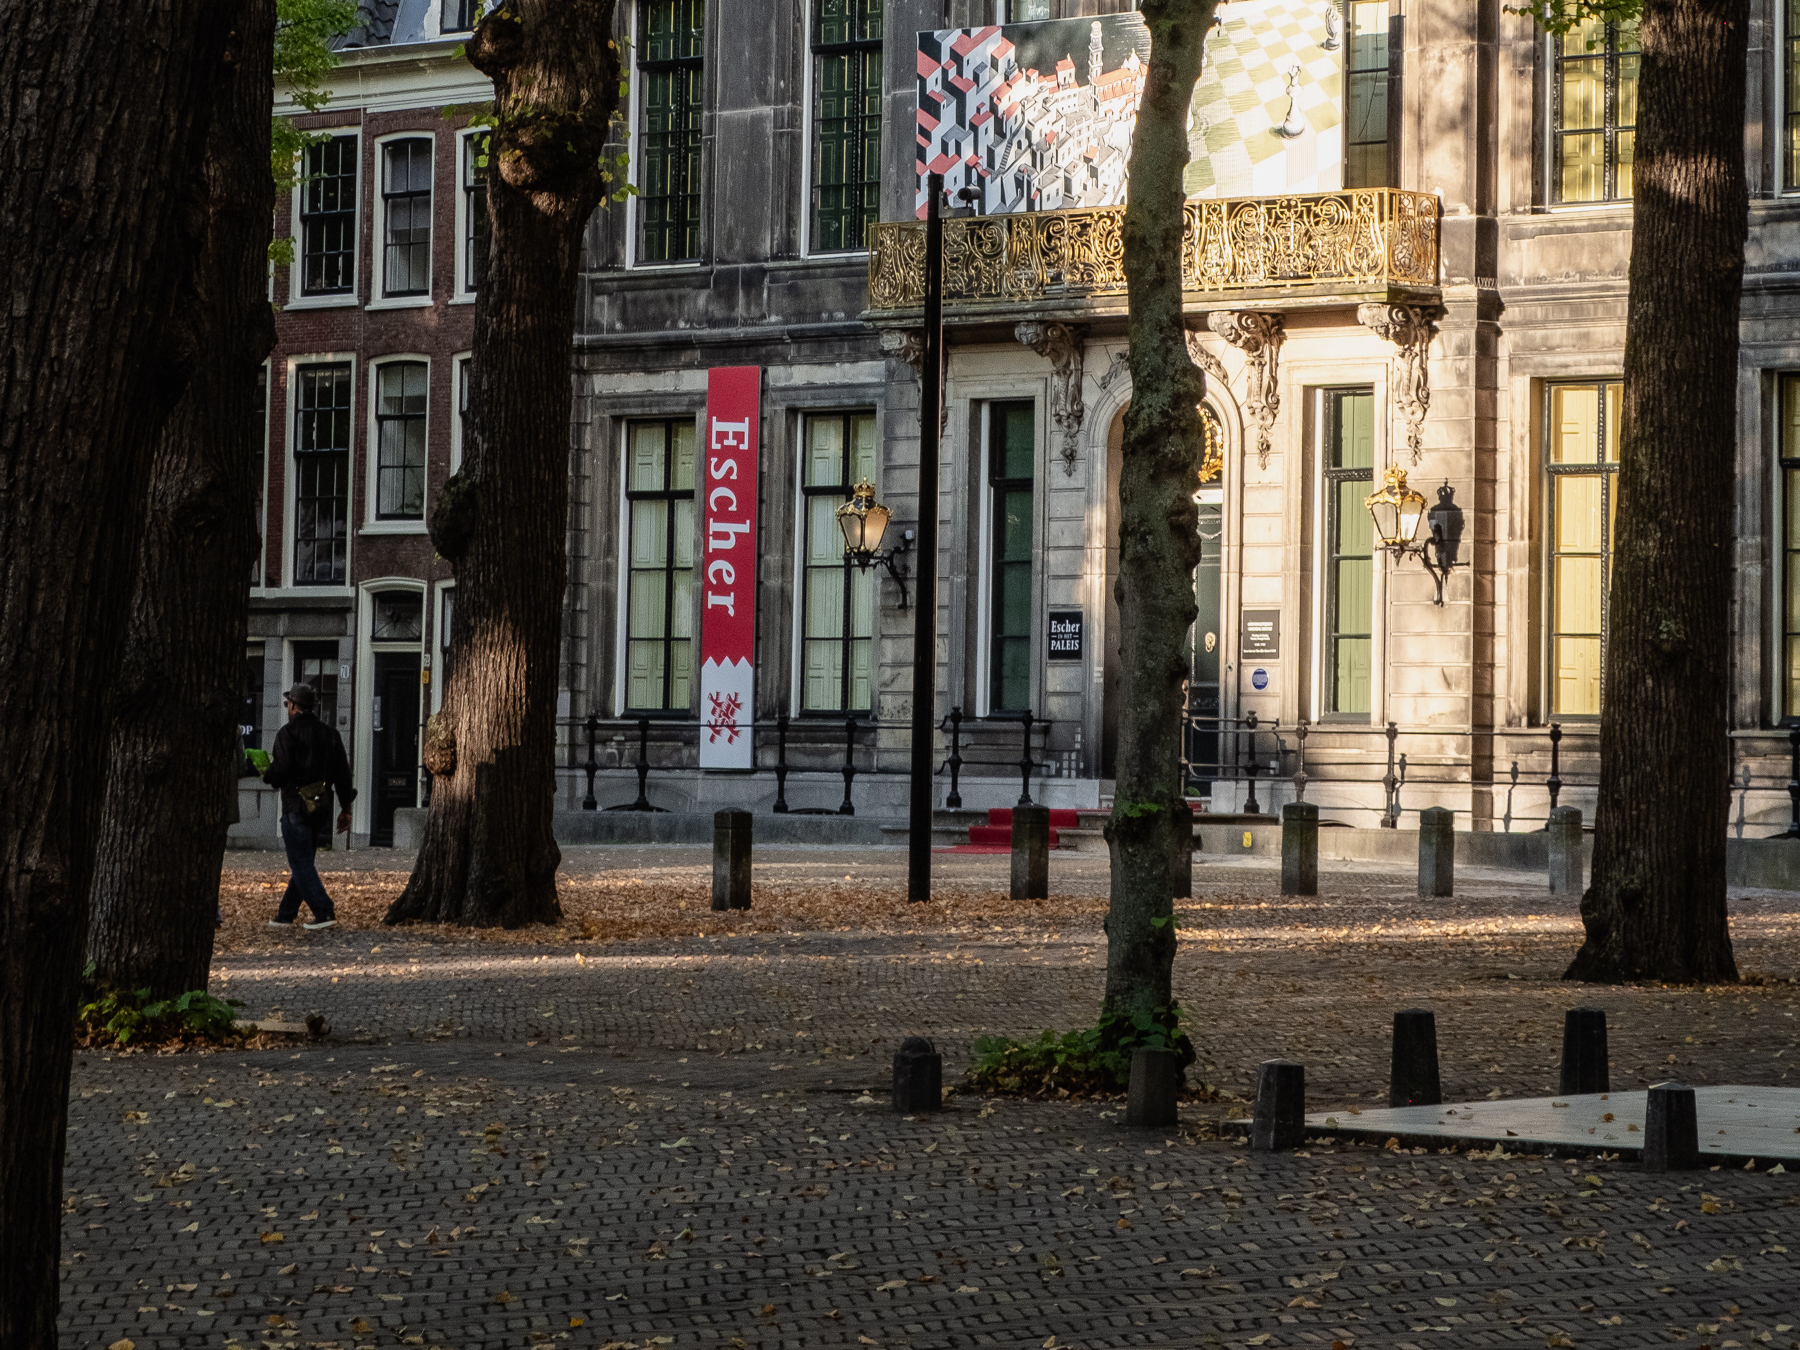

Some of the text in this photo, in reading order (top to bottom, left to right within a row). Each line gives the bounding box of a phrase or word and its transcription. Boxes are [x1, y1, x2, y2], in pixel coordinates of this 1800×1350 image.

[707, 416, 751, 617] Escher
[1051, 619, 1080, 632] Escher
[1051, 640, 1079, 650] PALEIS
